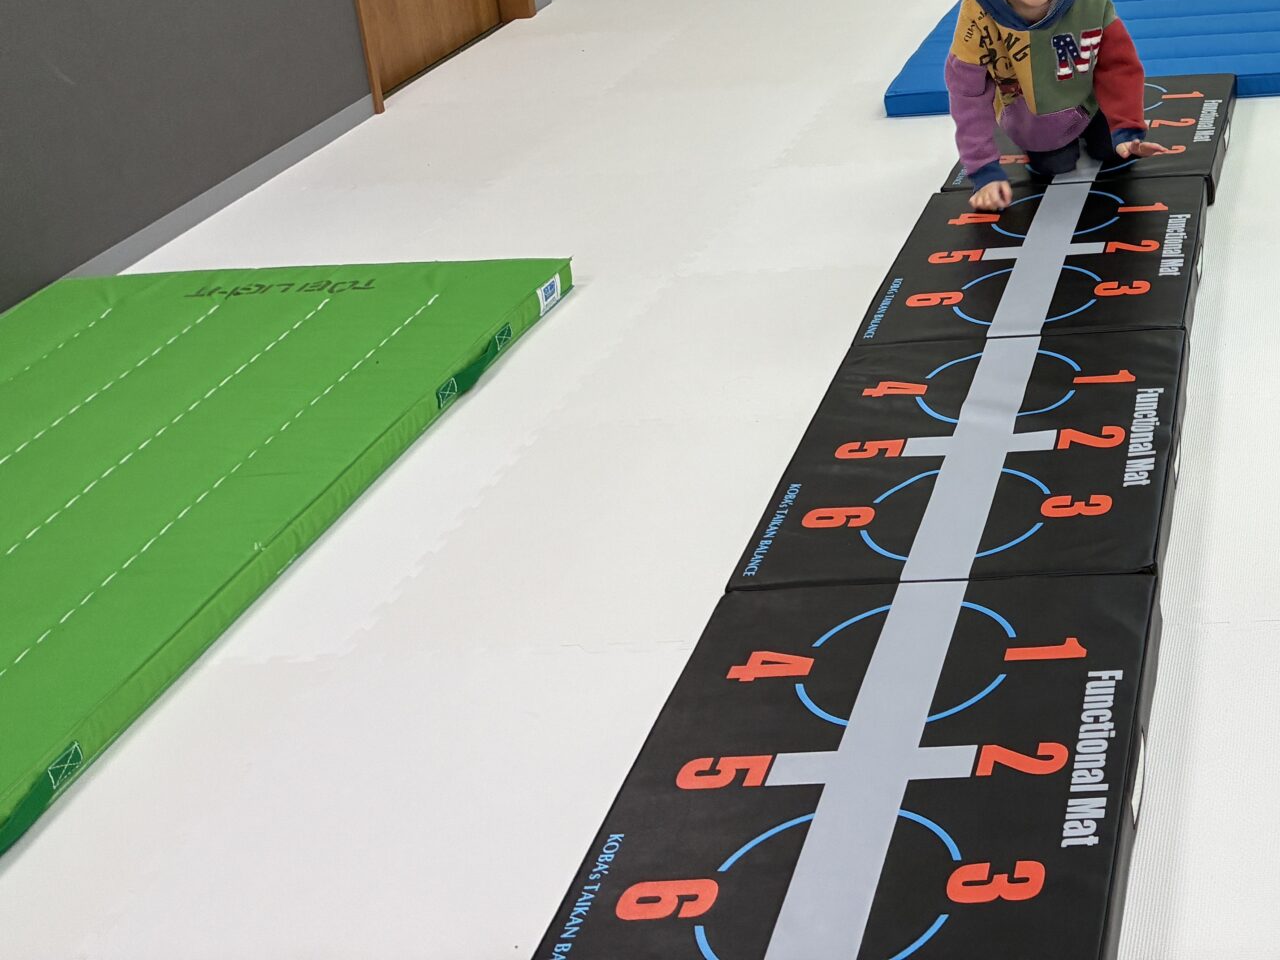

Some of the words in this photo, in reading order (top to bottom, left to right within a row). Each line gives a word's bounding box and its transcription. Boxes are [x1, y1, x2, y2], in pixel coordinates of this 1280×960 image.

[1161, 91, 1204, 99] 1
[1151, 118, 1196, 128] 2
[947, 212, 1001, 226] 4
[1118, 202, 1169, 213] 1
[1105, 239, 1160, 253] 2
[1161, 213, 1192, 258] Functional
[927, 248, 984, 265] 5
[1158, 258, 1185, 277] Mat
[905, 291, 964, 308] 6
[1093, 280, 1151, 297] 3
[862, 380, 928, 398] 4
[1073, 369, 1137, 384] 1
[1125, 387, 1165, 455] Functional
[834, 438, 906, 460] 5
[1056, 425, 1126, 450] 2
[1122, 457, 1157, 487] Mat
[801, 506, 876, 529] 6
[1040, 494, 1113, 518] 3
[763, 508, 789, 538] TAIKAN
[743, 539, 772, 577] BALANCE
[1003, 637, 1088, 662] 1
[726, 650, 815, 682] 4
[1068, 669, 1124, 794] Functional
[675, 754, 773, 790] 5
[975, 742, 1069, 777] 2
[1059, 797, 1108, 848] Mat
[946, 860, 1046, 904] 3
[559, 882, 601, 938] TAIKAN
[615, 878, 720, 921] 6
